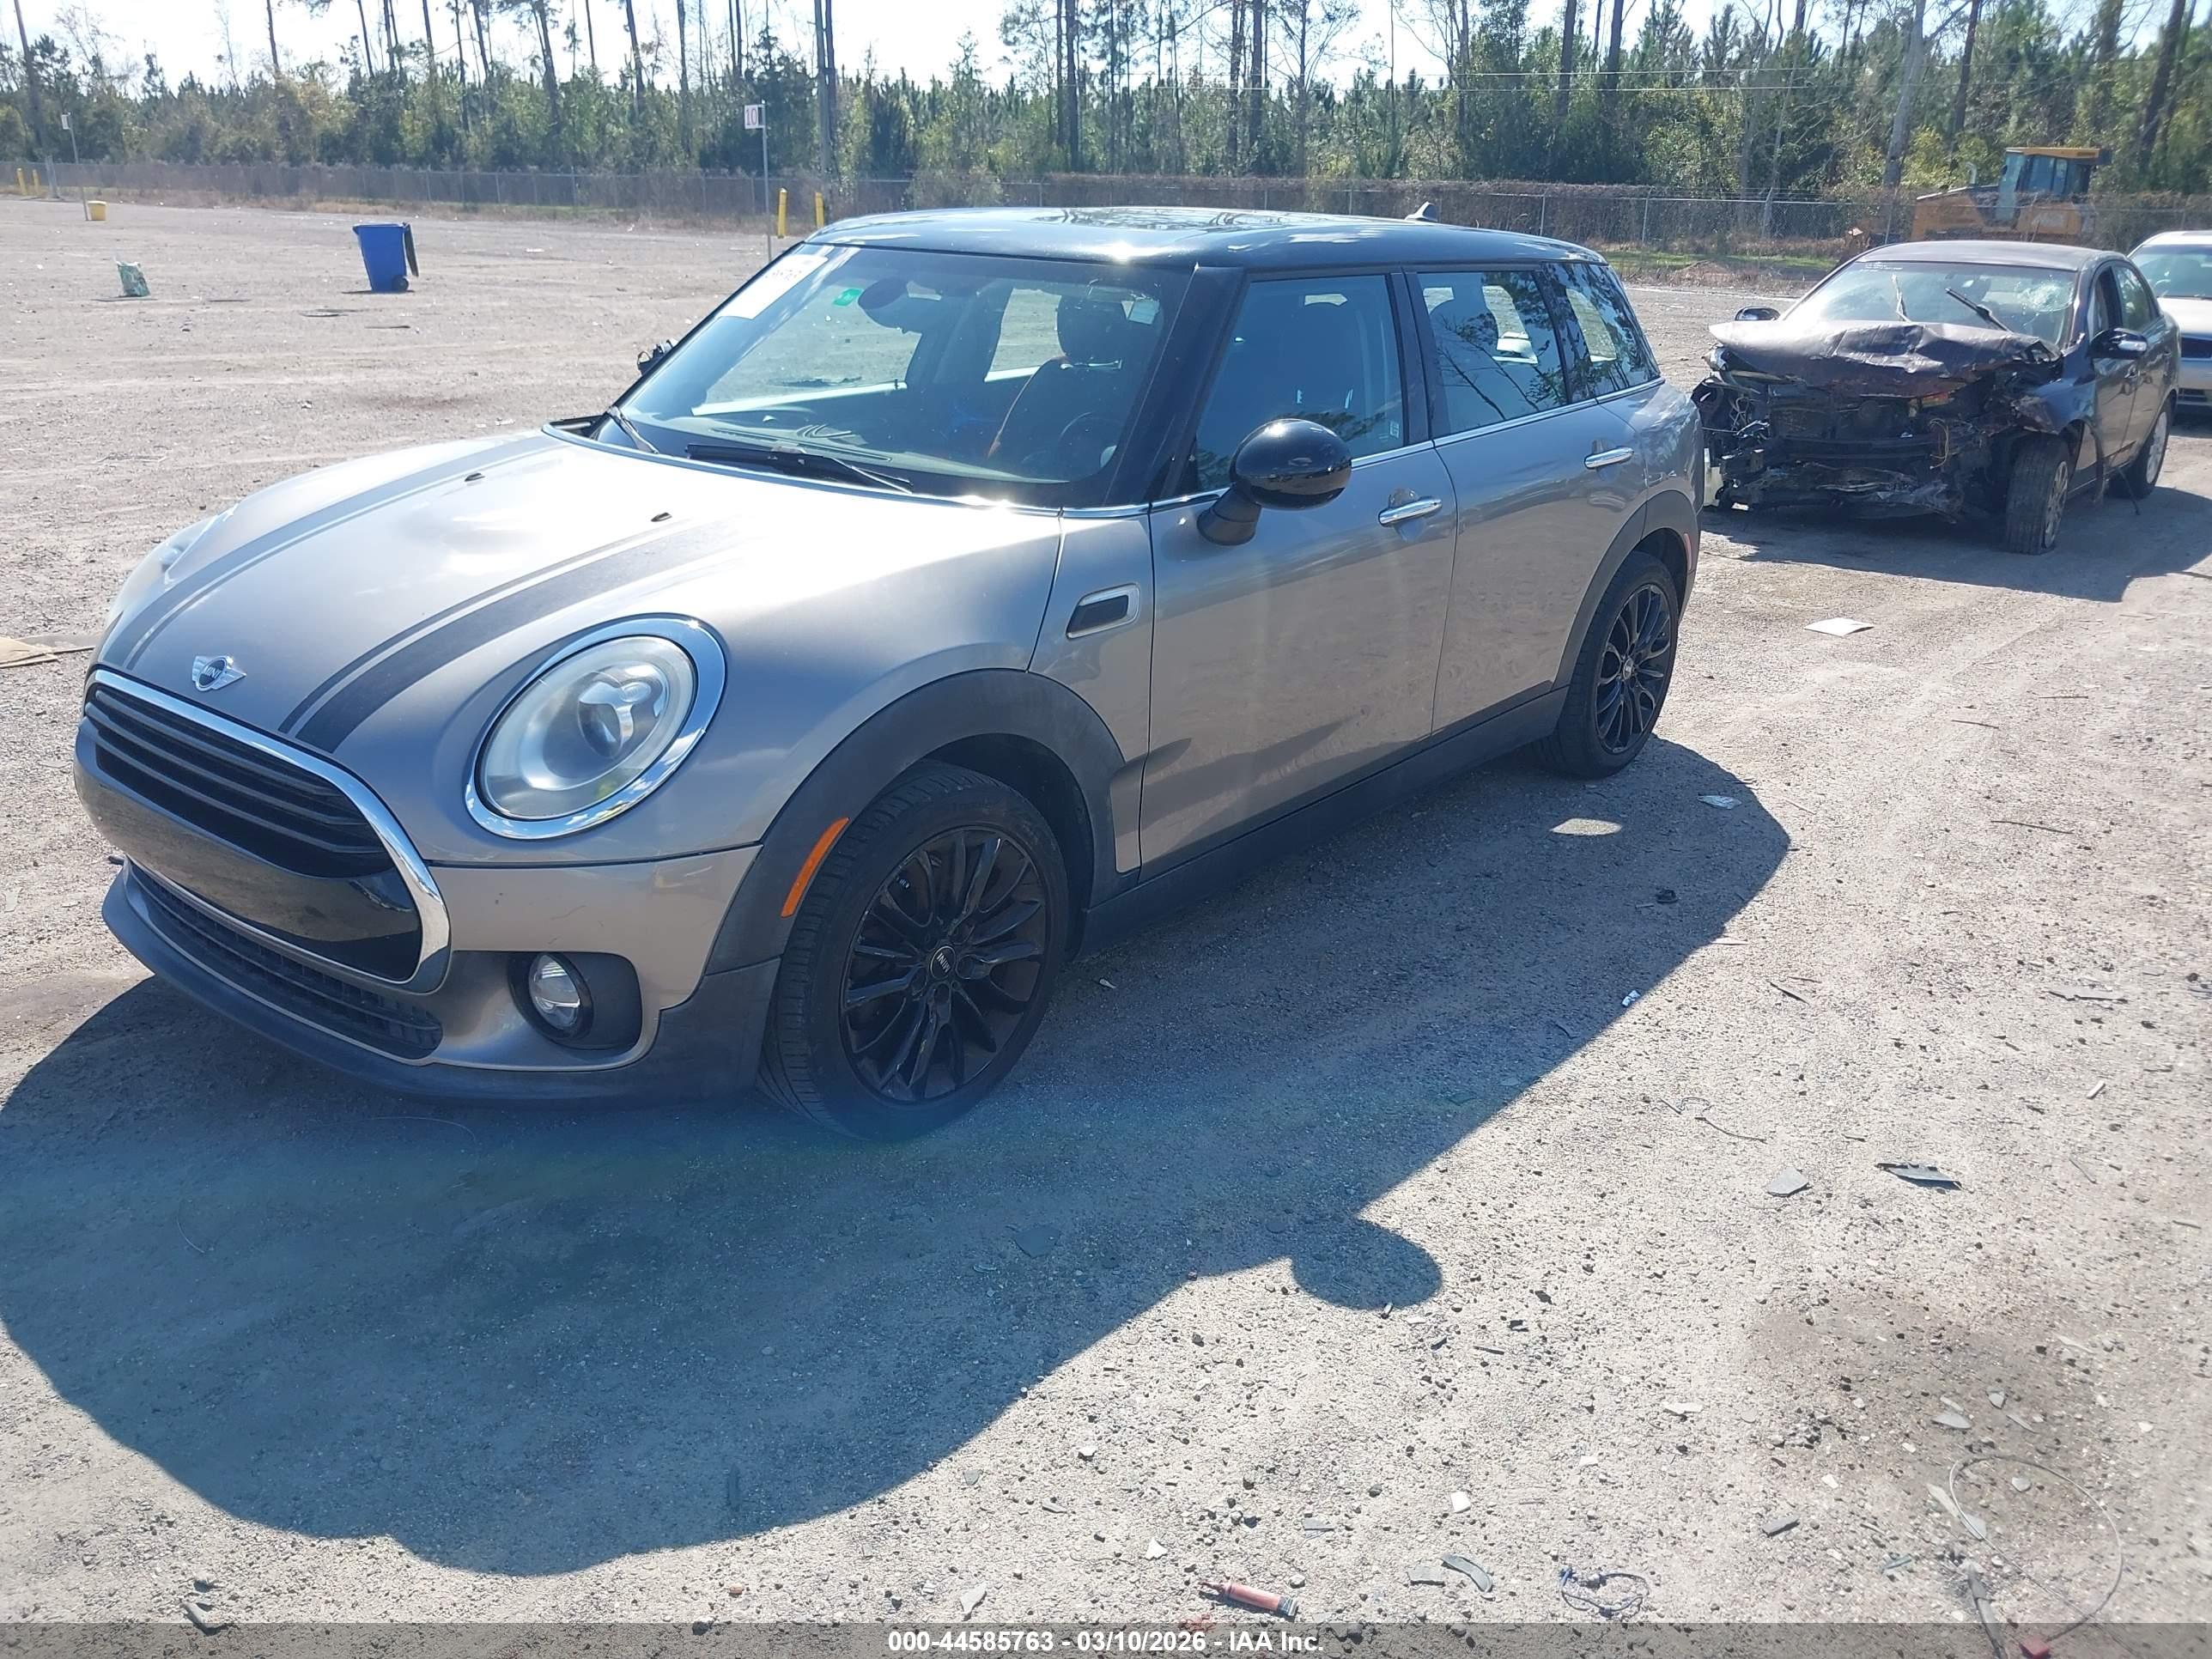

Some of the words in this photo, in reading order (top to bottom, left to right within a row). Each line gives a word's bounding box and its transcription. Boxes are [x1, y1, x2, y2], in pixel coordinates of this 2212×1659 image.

[745, 108, 758, 125] 10
[204, 665, 222, 678] MINI
[936, 952, 951, 973] MINI
